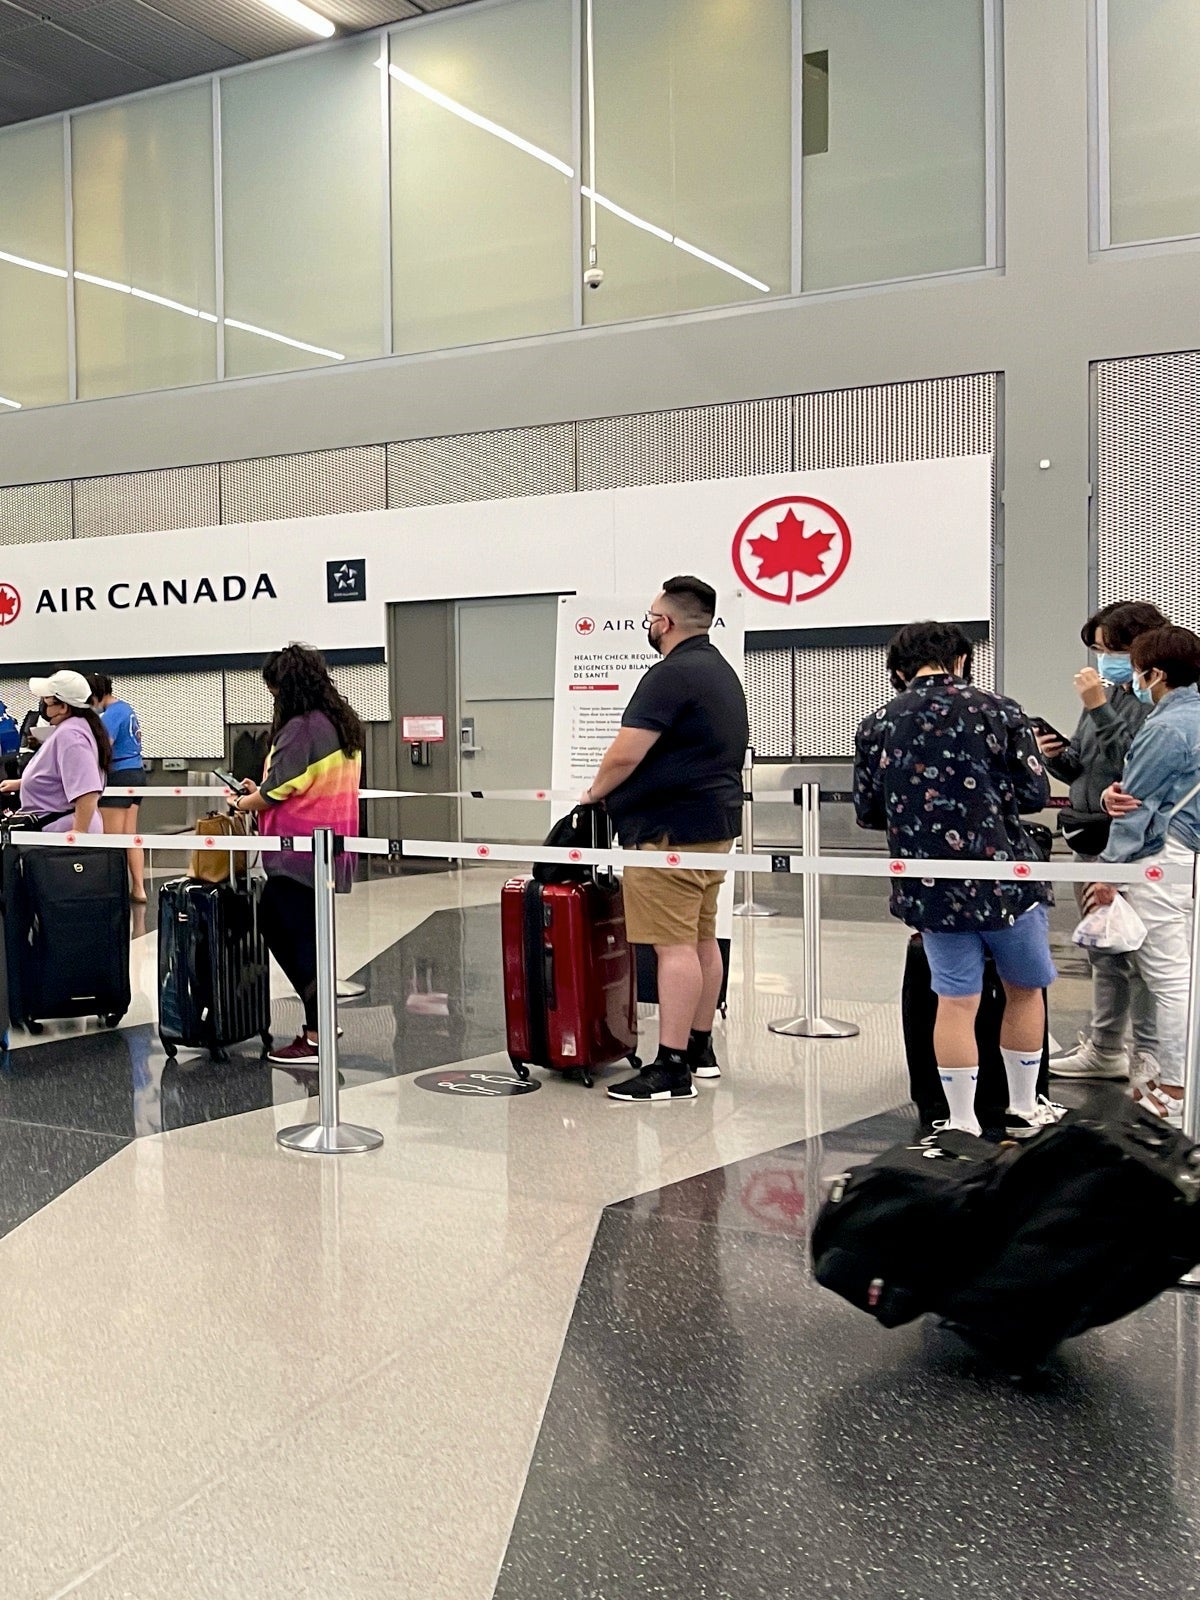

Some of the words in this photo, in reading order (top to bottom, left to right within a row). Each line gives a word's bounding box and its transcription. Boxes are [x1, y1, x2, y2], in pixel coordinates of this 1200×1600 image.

[35, 585, 97, 613] AIR
[107, 573, 278, 609] CANADA
[603, 619, 635, 631] AIR
[585, 671, 609, 679] SANTÉ
